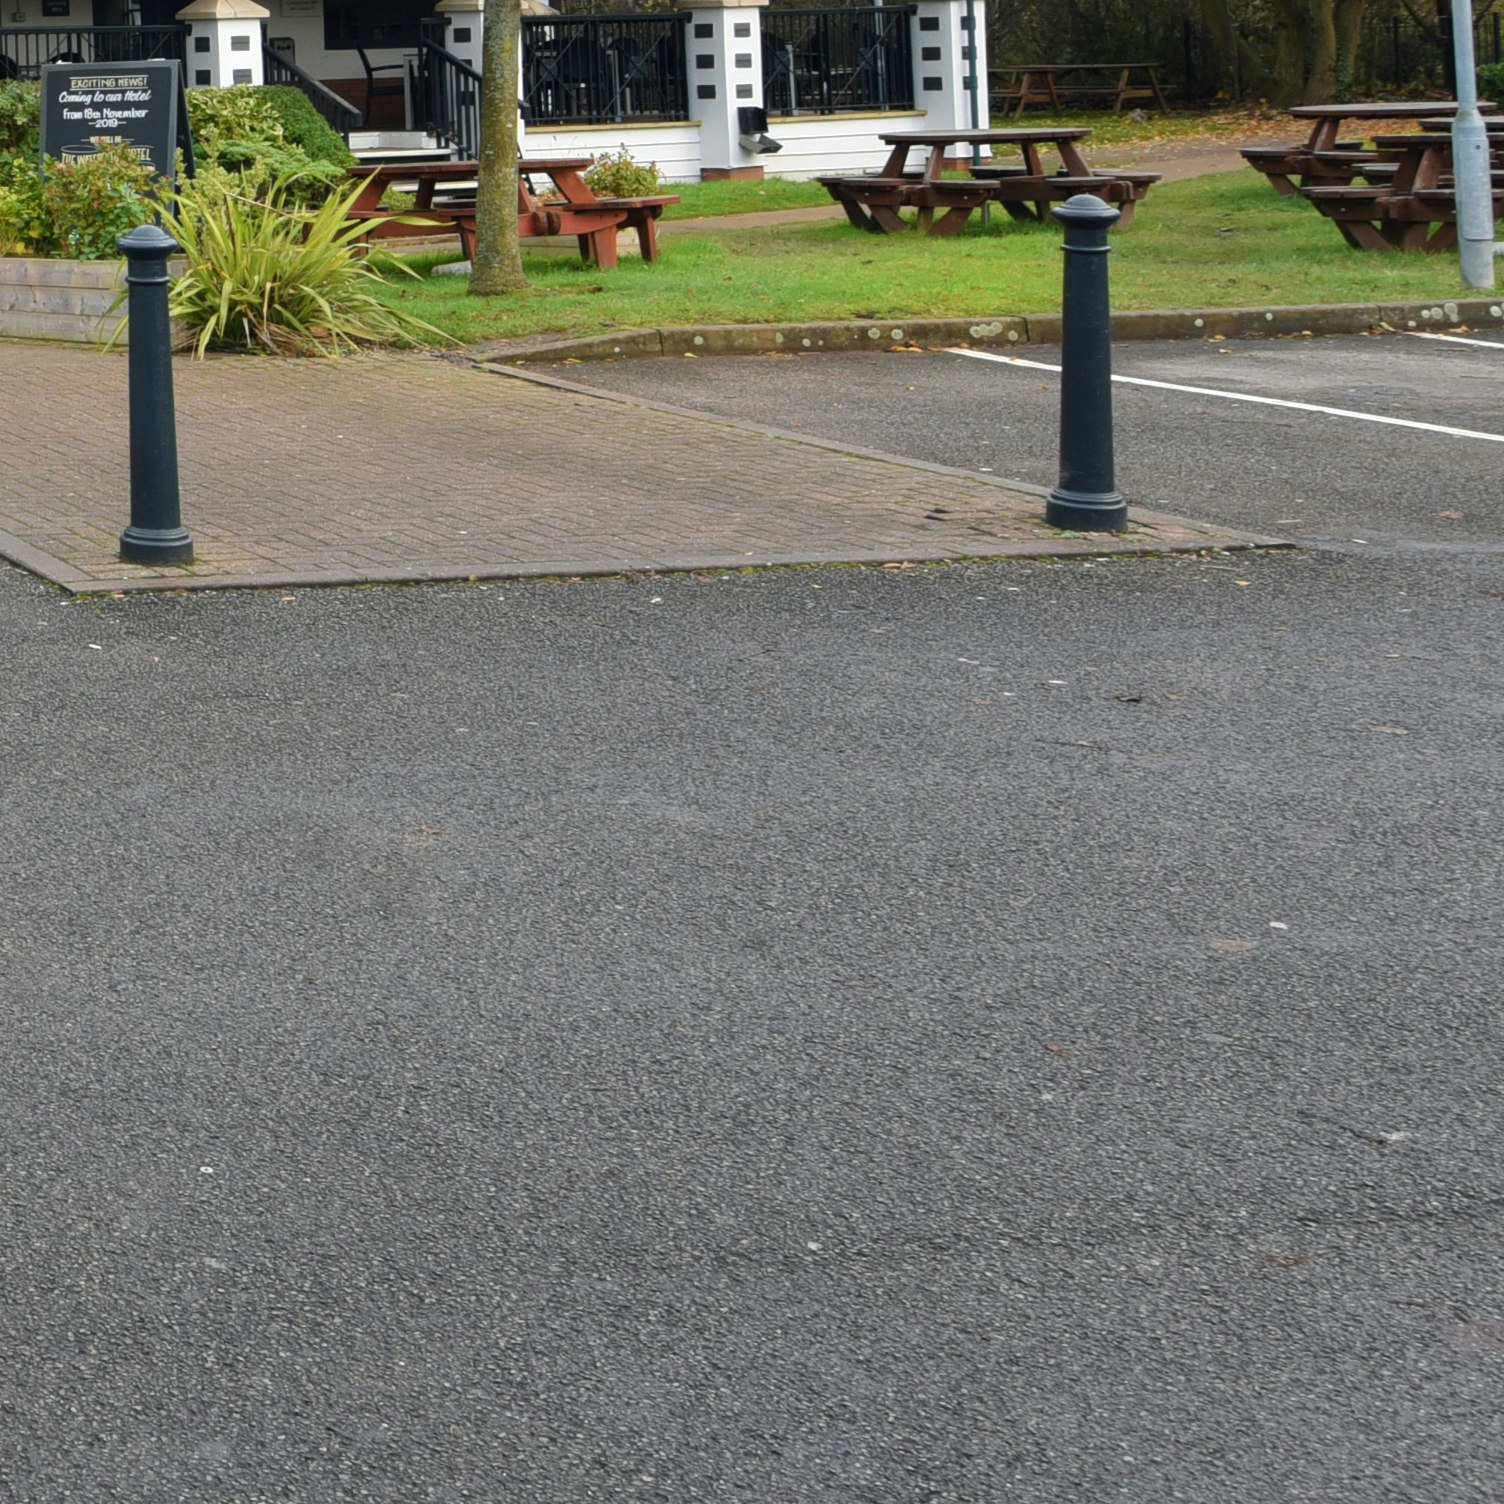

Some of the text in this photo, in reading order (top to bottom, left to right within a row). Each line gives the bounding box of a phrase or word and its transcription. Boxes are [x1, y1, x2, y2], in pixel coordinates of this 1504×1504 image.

[72, 77, 147, 88] EXCITING NEWS!
[58, 90, 151, 105] Coming to our Hotel
[84, 107, 101, 119] 18th
[103, 107, 148, 118] November
[95, 118, 118, 128] 2019
